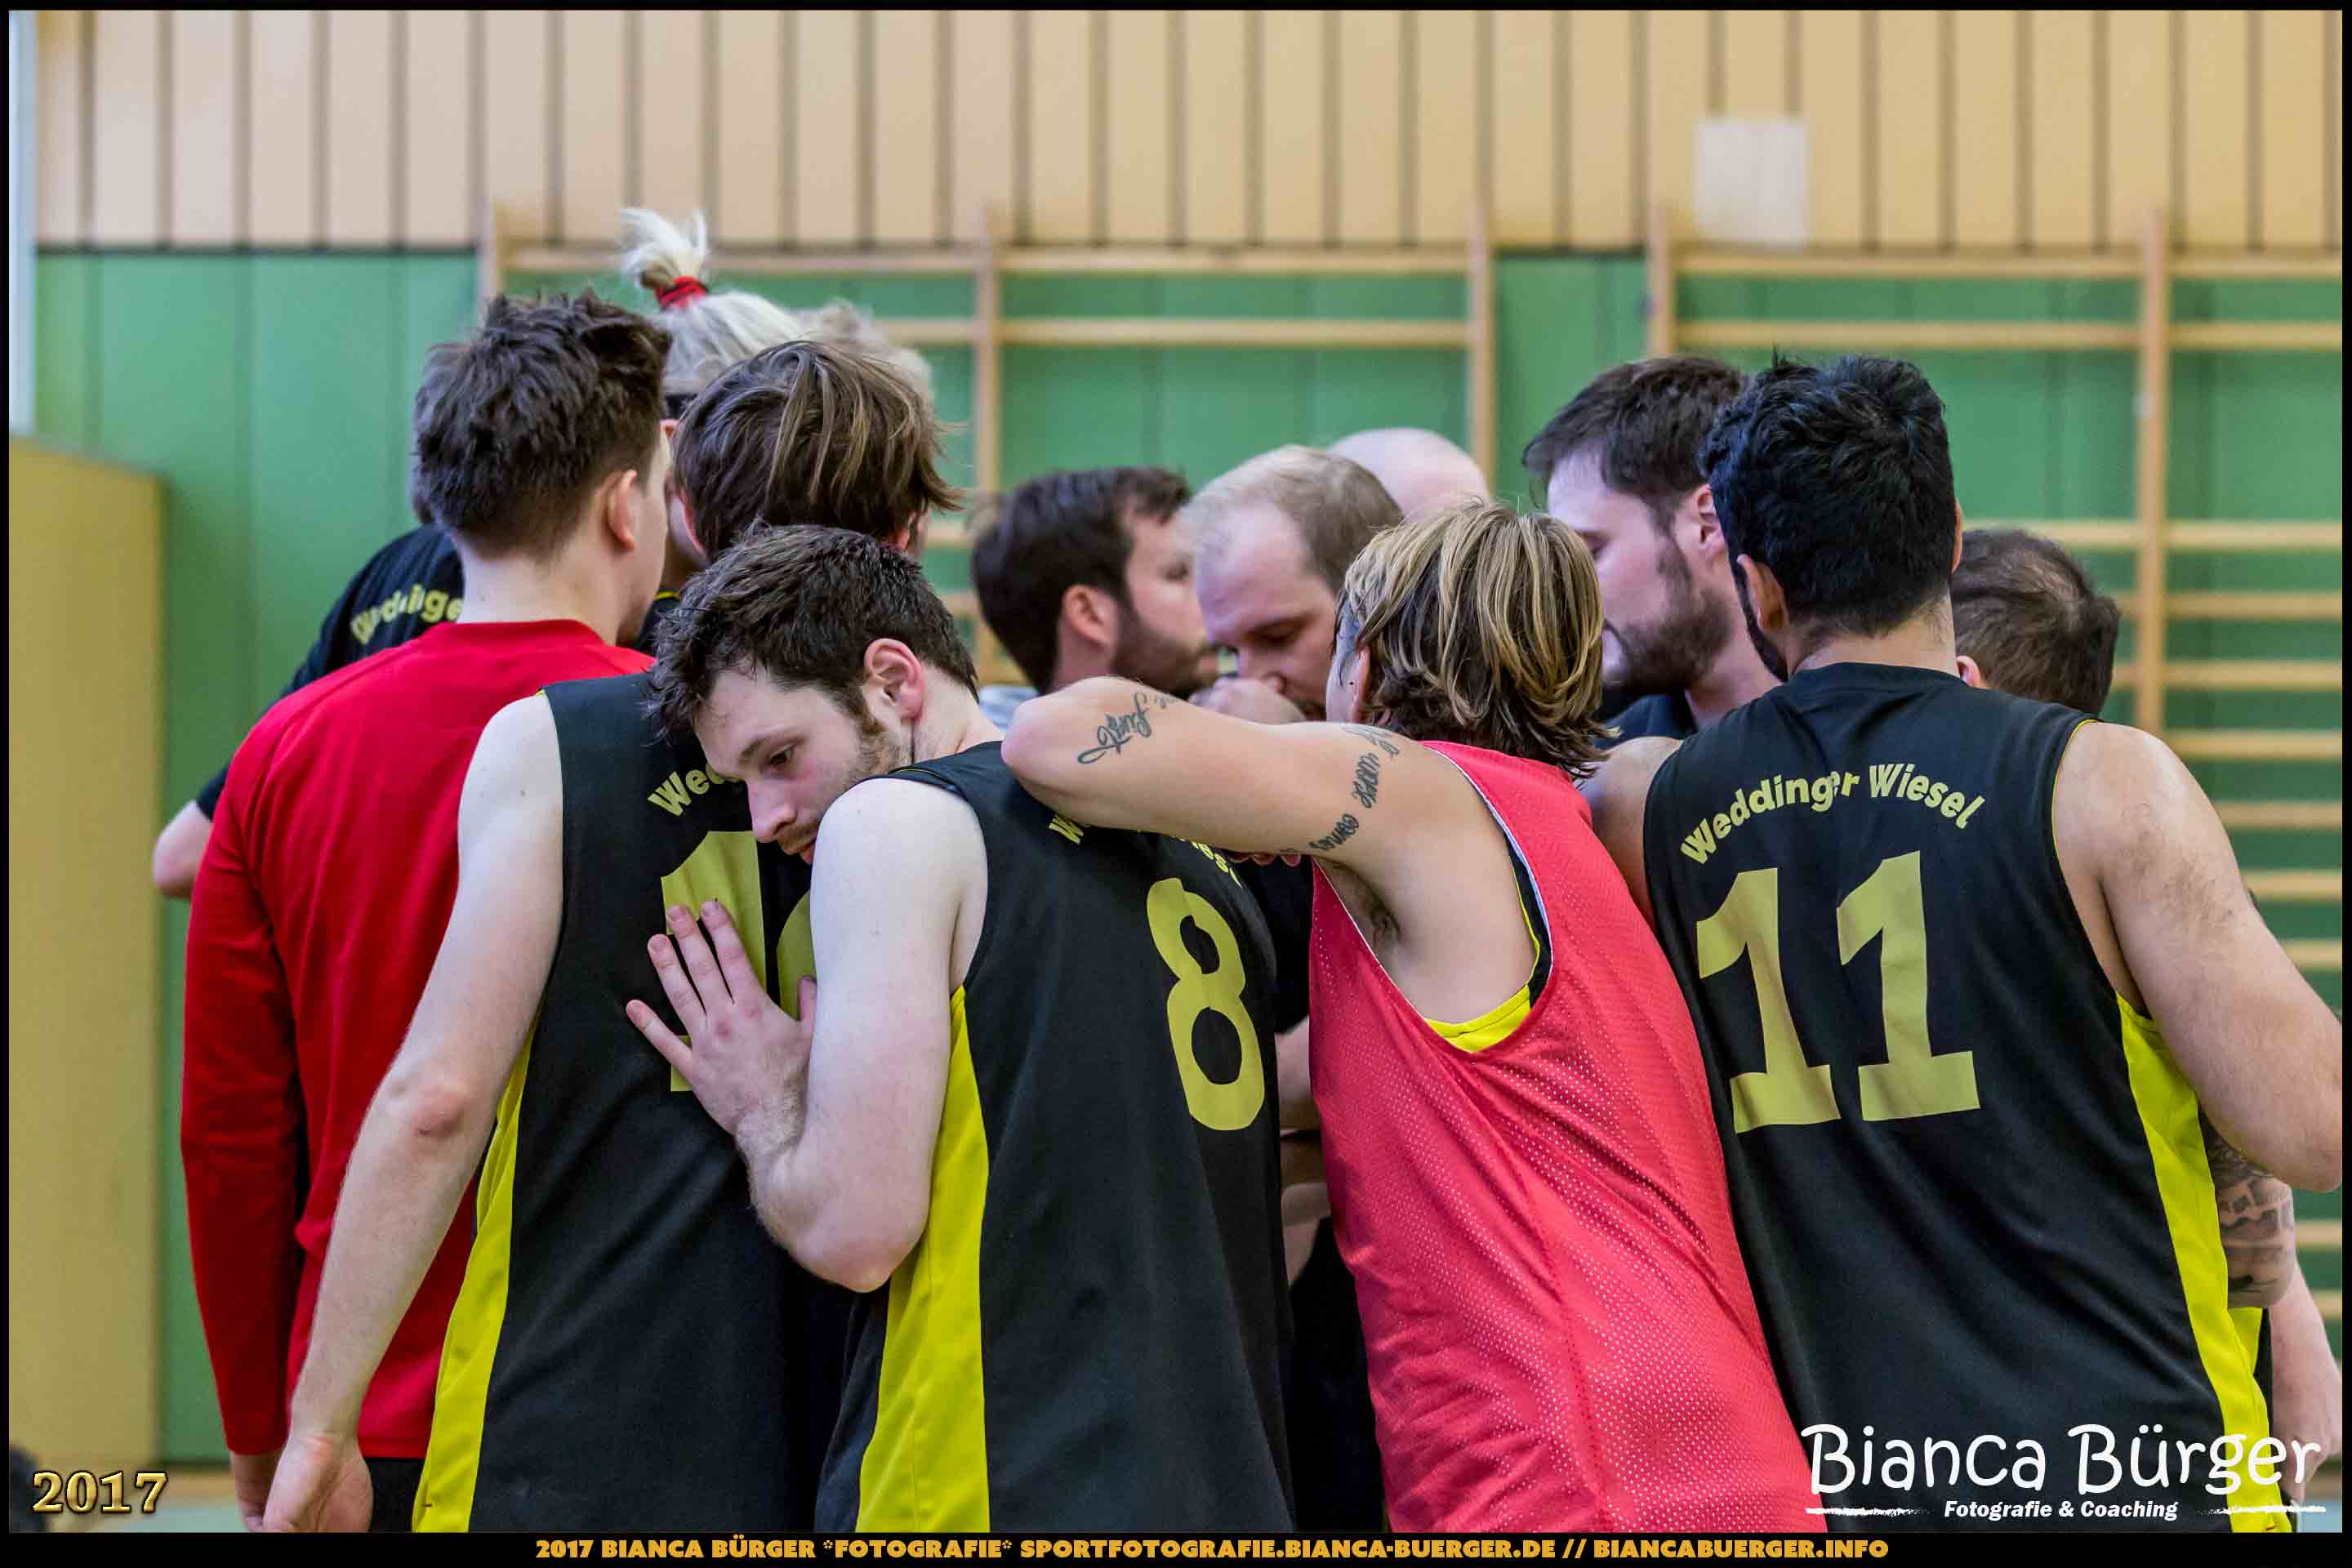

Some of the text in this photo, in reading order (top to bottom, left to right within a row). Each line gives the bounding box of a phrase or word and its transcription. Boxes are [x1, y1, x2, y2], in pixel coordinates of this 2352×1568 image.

[1680, 764, 1985, 865] Weddinger Wiesel
[1147, 877, 1265, 1131] 8
[1696, 850, 1980, 1134] 11
